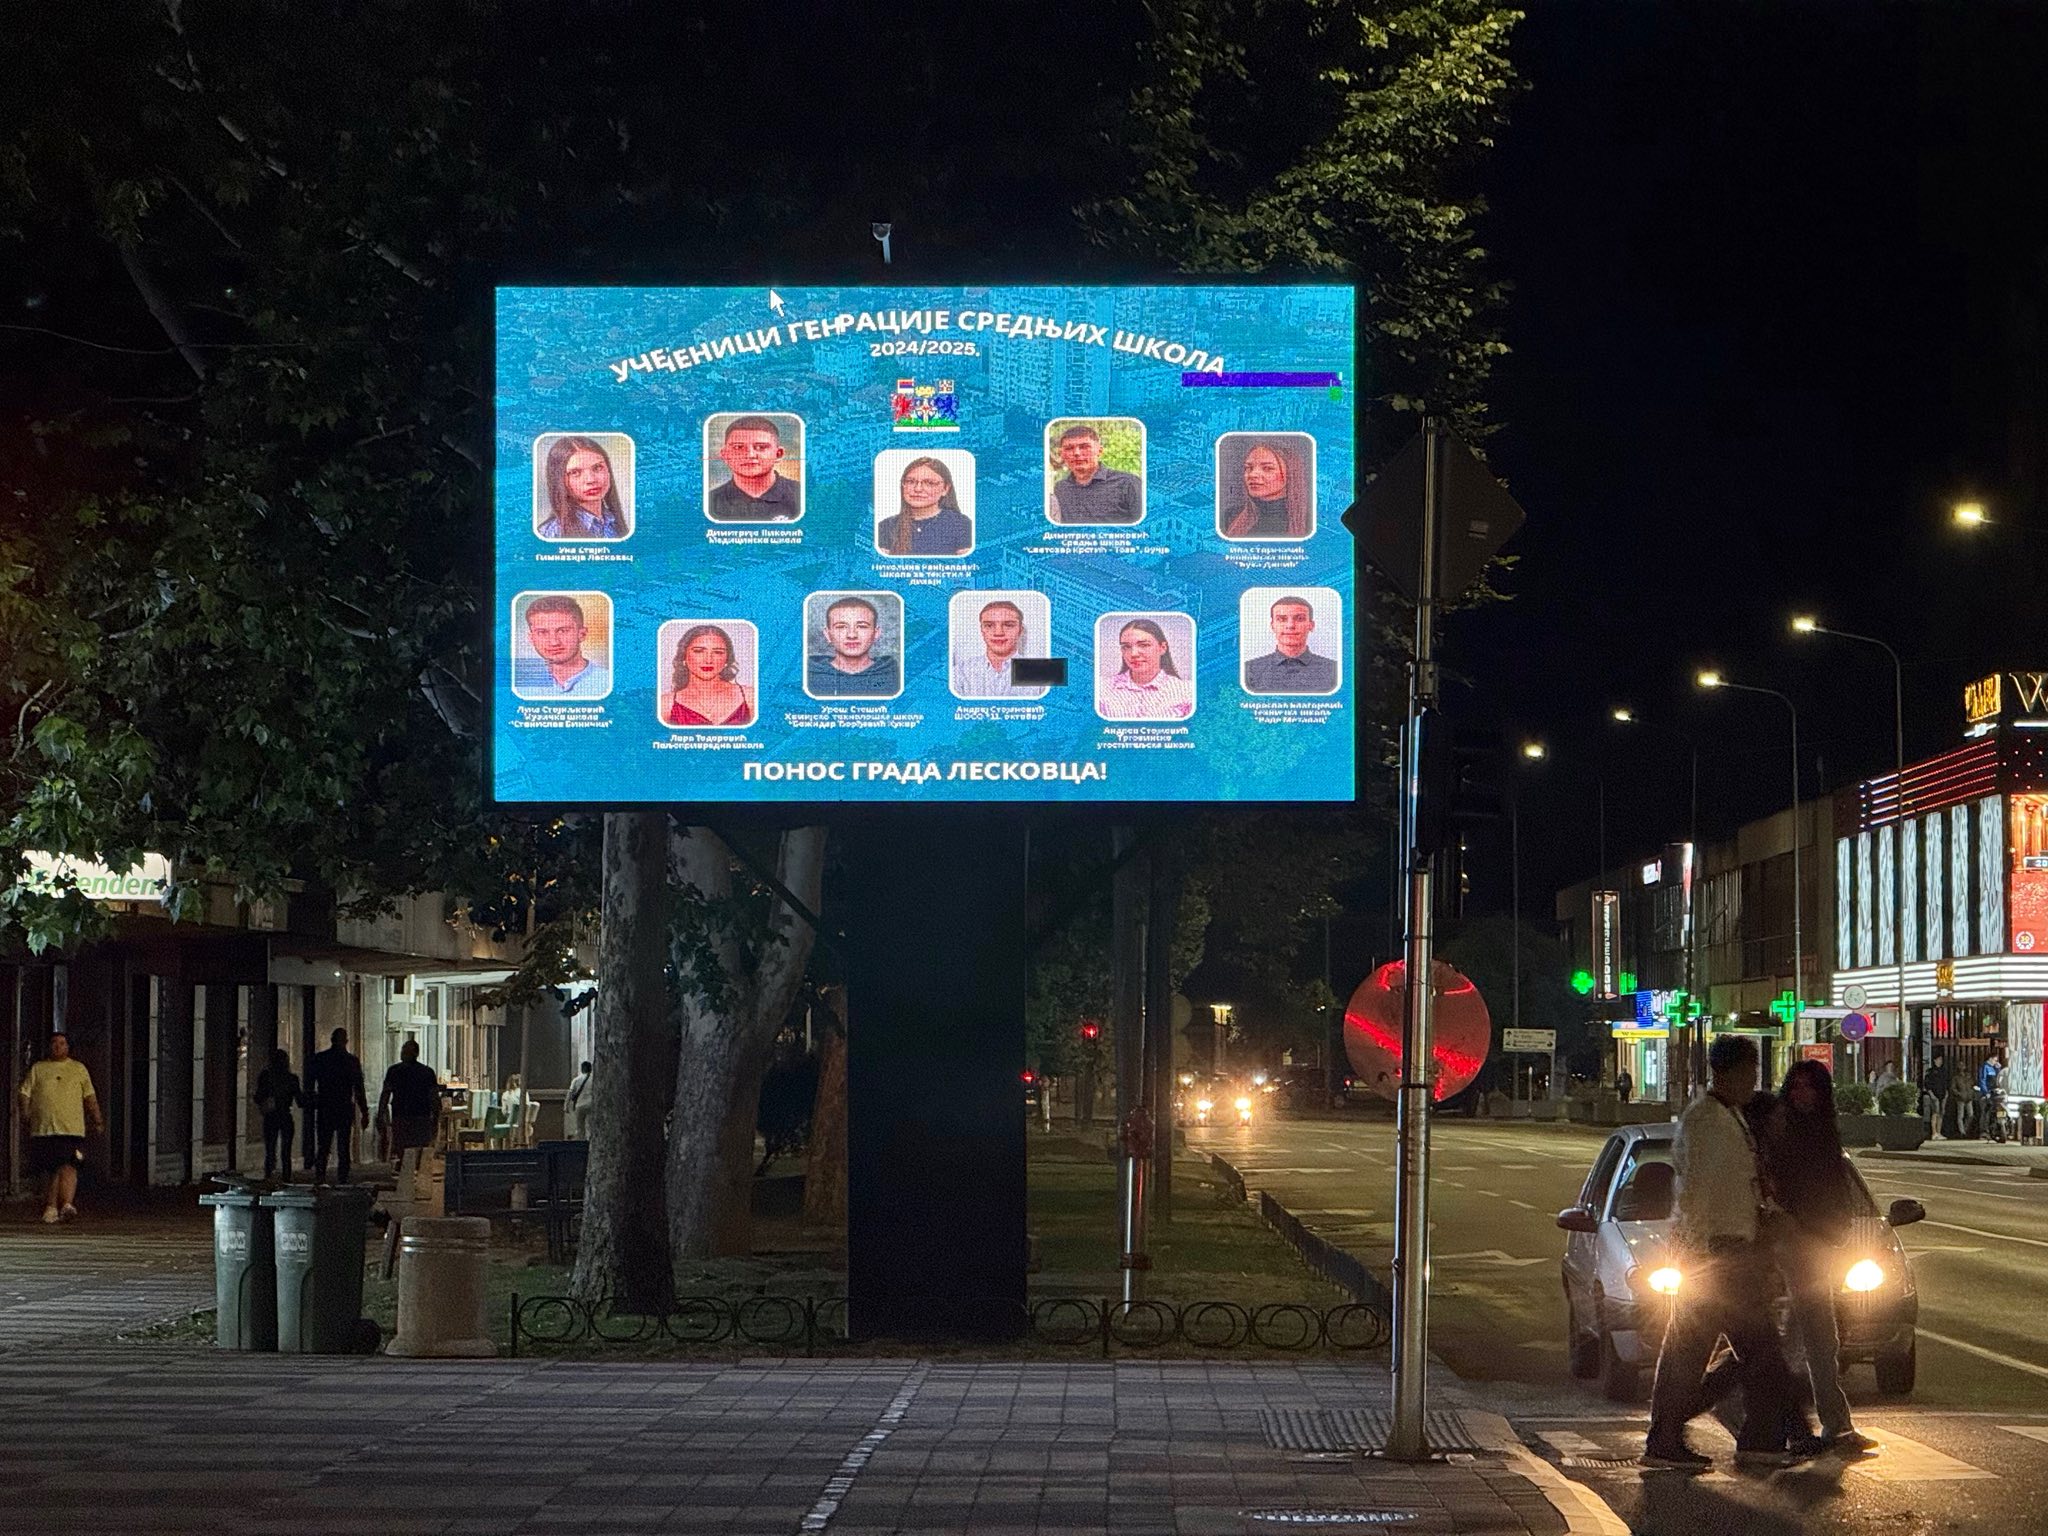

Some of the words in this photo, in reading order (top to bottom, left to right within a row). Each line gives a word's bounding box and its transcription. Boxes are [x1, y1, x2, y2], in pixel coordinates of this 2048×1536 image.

[870, 340, 980, 357] 2024/2025.
[958, 310, 1106, 347] СРЕДЊИХ
[1112, 330, 1226, 376] ШКОЛА
[535, 554, 586, 562] Гимназија
[587, 554, 634, 562] Лесковац
[893, 713, 924, 721] школа
[743, 762, 845, 781] ПОНОС
[852, 762, 942, 785] ГРАДА
[947, 762, 1107, 785] ЛЕСКОВЦА!
